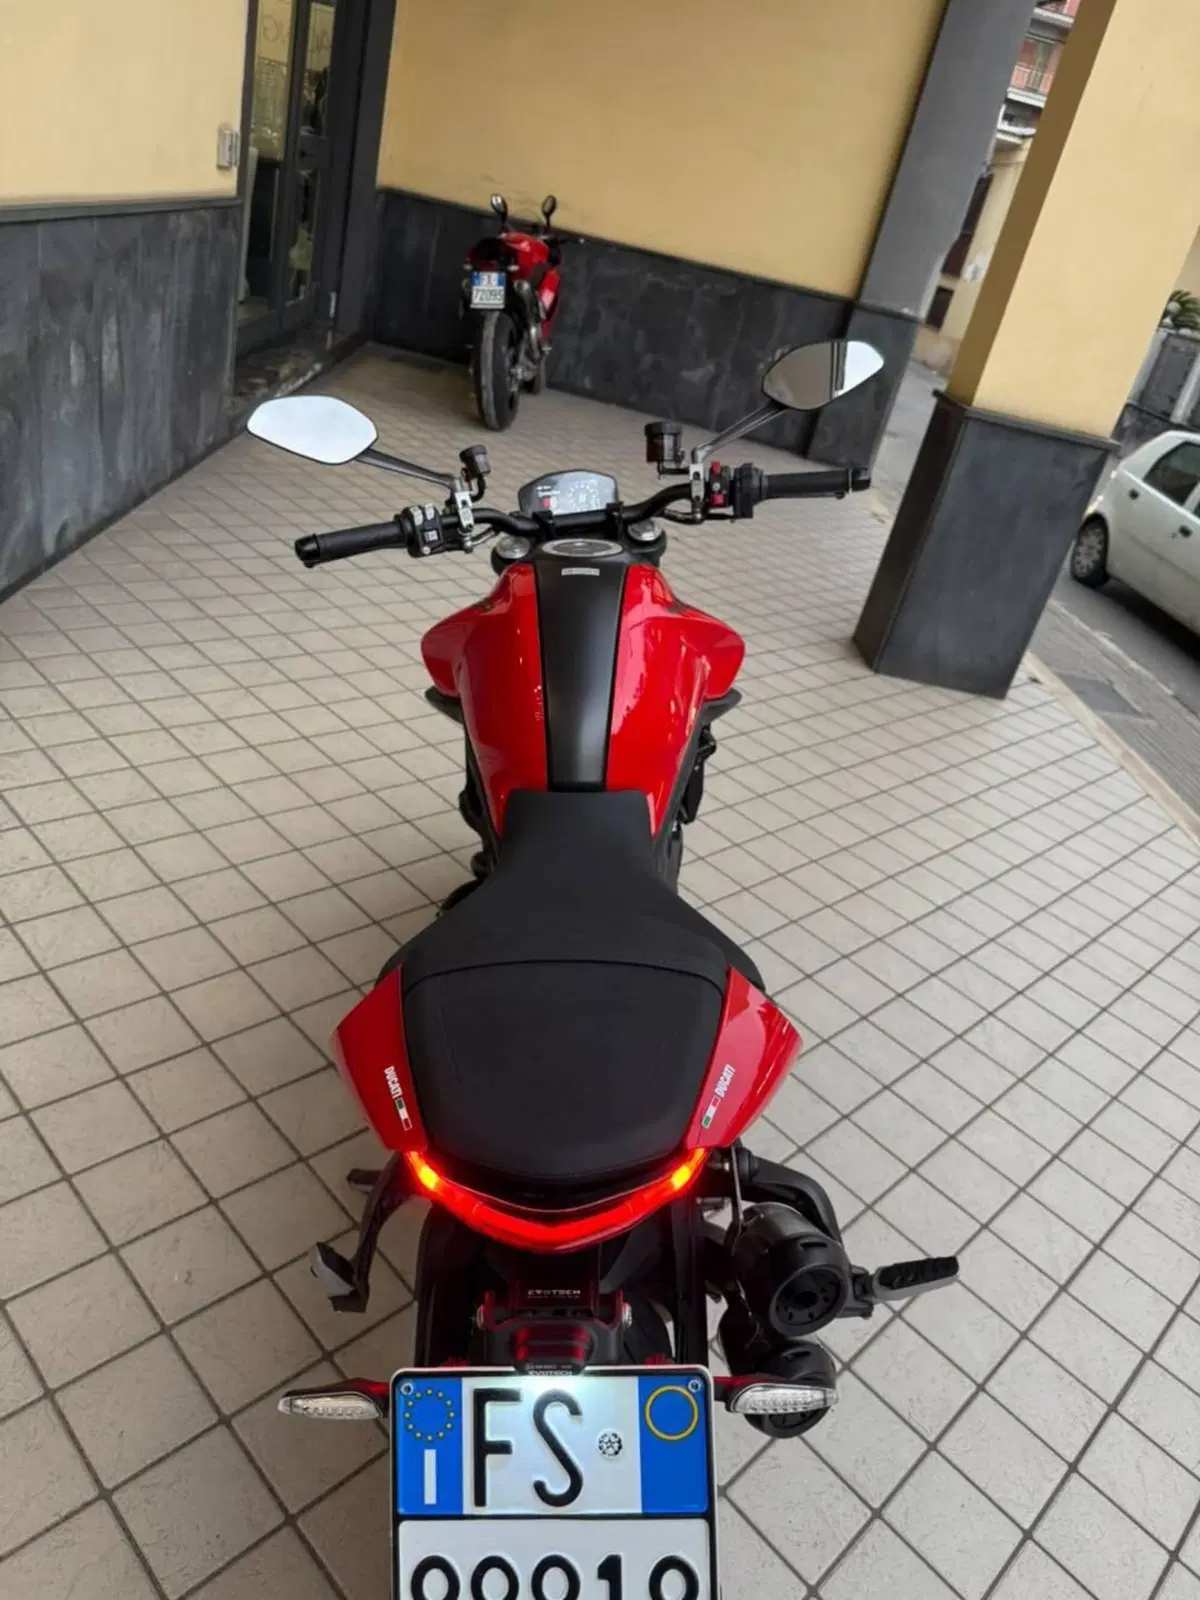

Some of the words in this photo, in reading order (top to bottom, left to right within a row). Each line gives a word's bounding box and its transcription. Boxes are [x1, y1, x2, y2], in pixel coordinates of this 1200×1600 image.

[384, 1065, 403, 1099] DUCATI
[714, 1063, 736, 1098] DUCATI
[472, 1386, 584, 1507] FS
[423, 1448, 437, 1505] I
